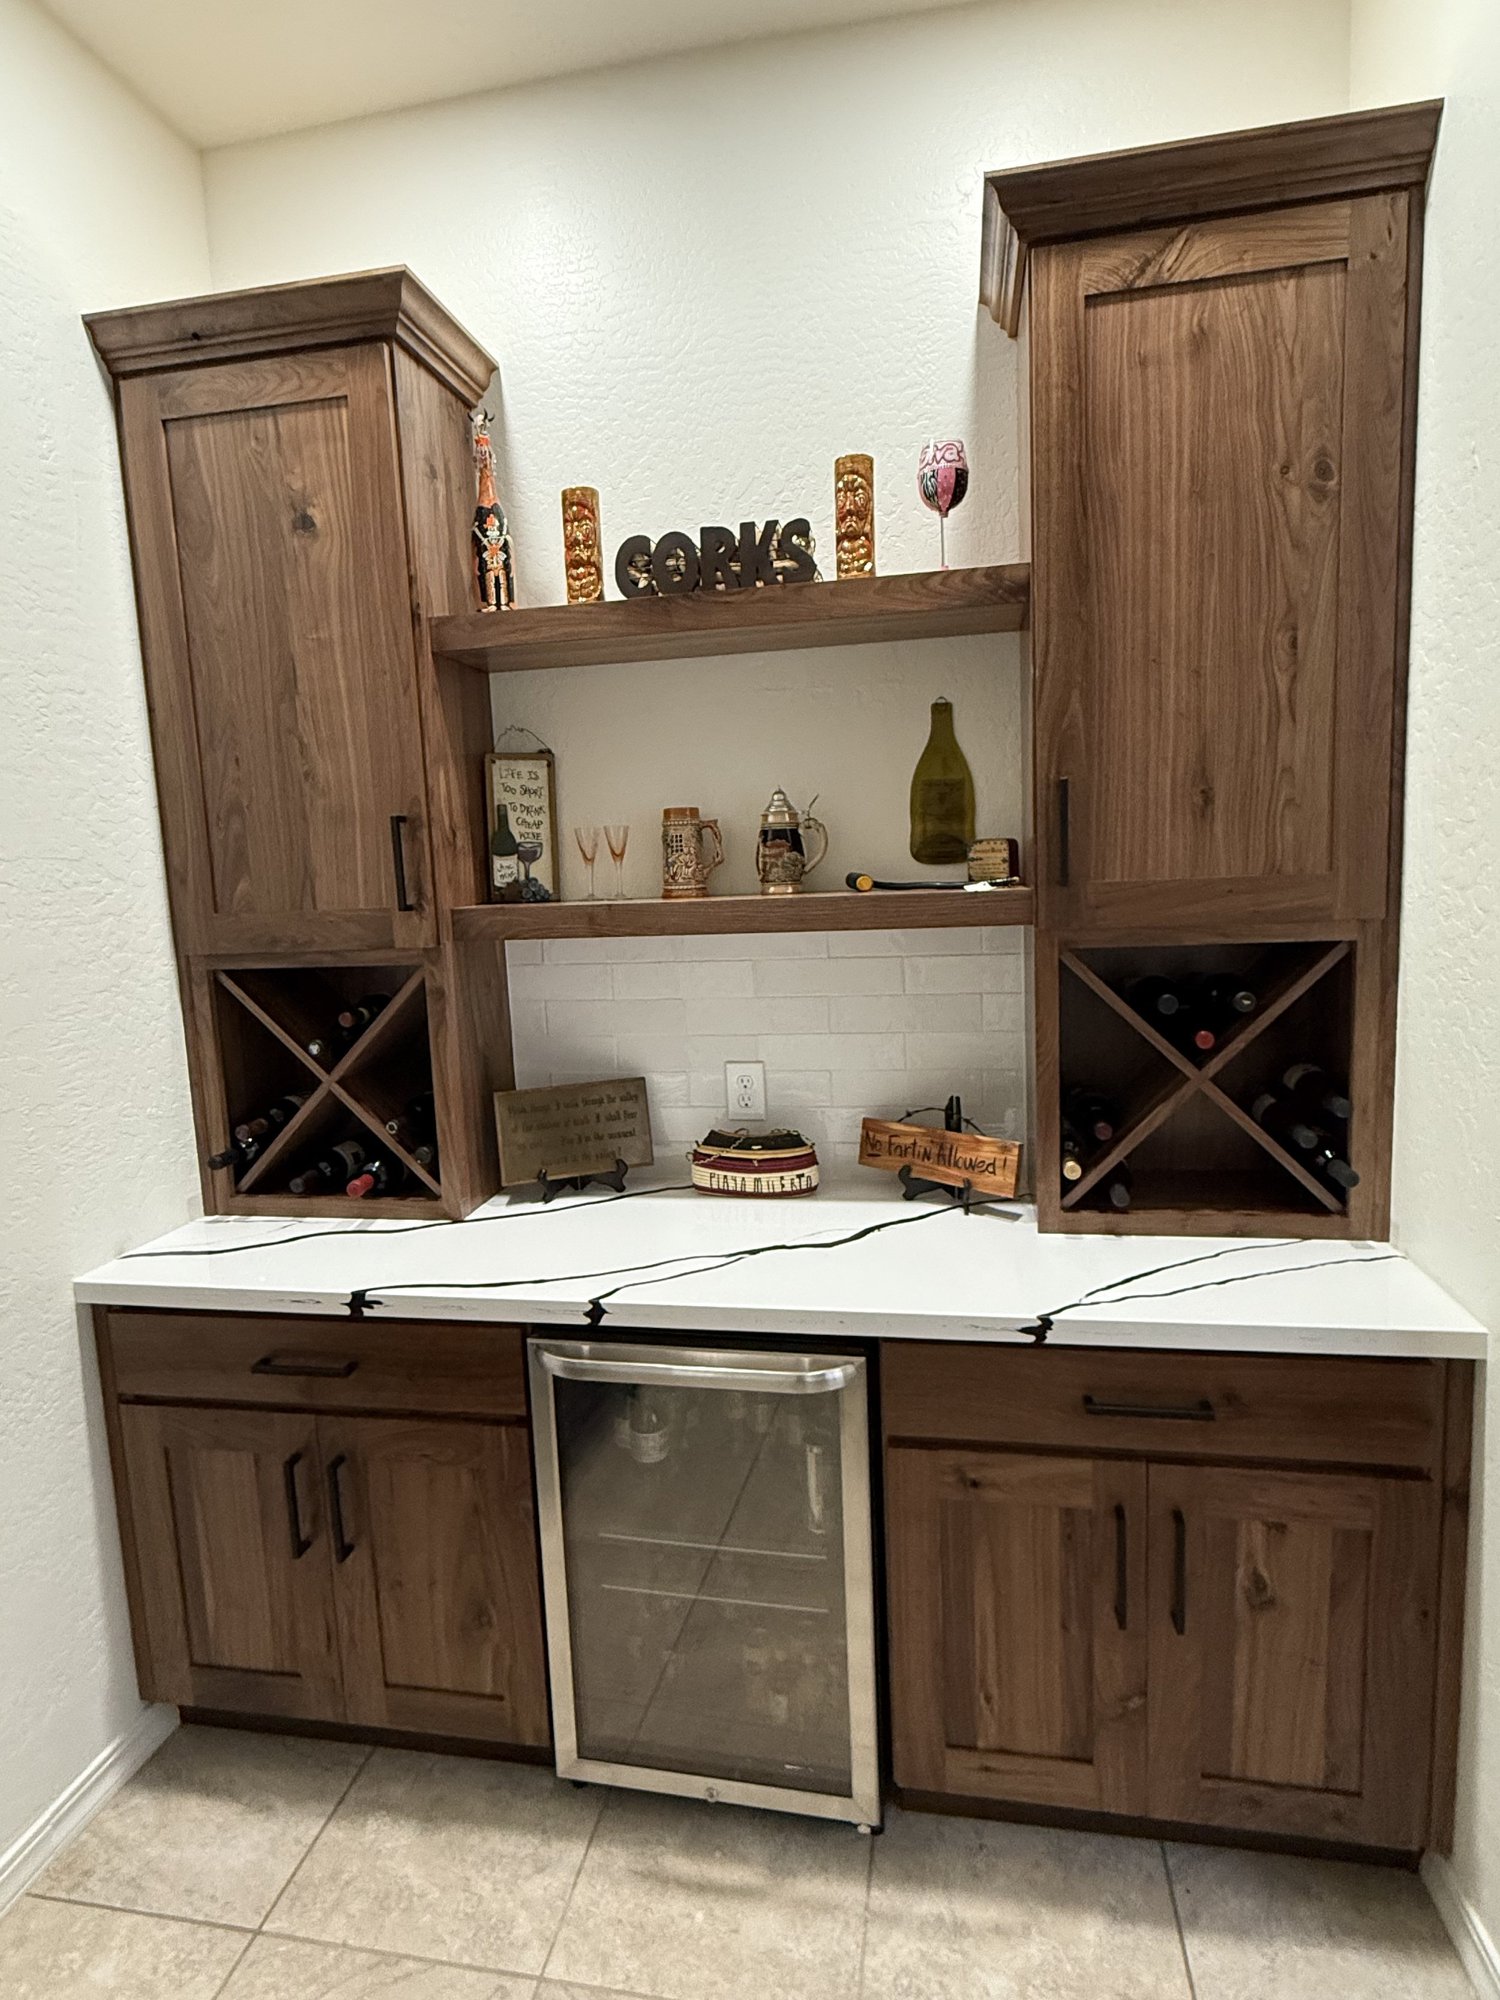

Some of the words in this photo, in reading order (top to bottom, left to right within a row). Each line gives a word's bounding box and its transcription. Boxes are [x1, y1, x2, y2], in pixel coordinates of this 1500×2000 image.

[615, 518, 817, 600] CORKS
[499, 767, 523, 779] LIFE
[527, 770, 540, 780] IS
[500, 782, 517, 795] TOO
[520, 784, 544, 799] SHORT
[508, 802, 518, 812] TO
[520, 803, 546, 817] DRINK
[516, 817, 543, 829] CHEAP
[519, 831, 542, 840] WINE
[865, 1130, 882, 1152] No
